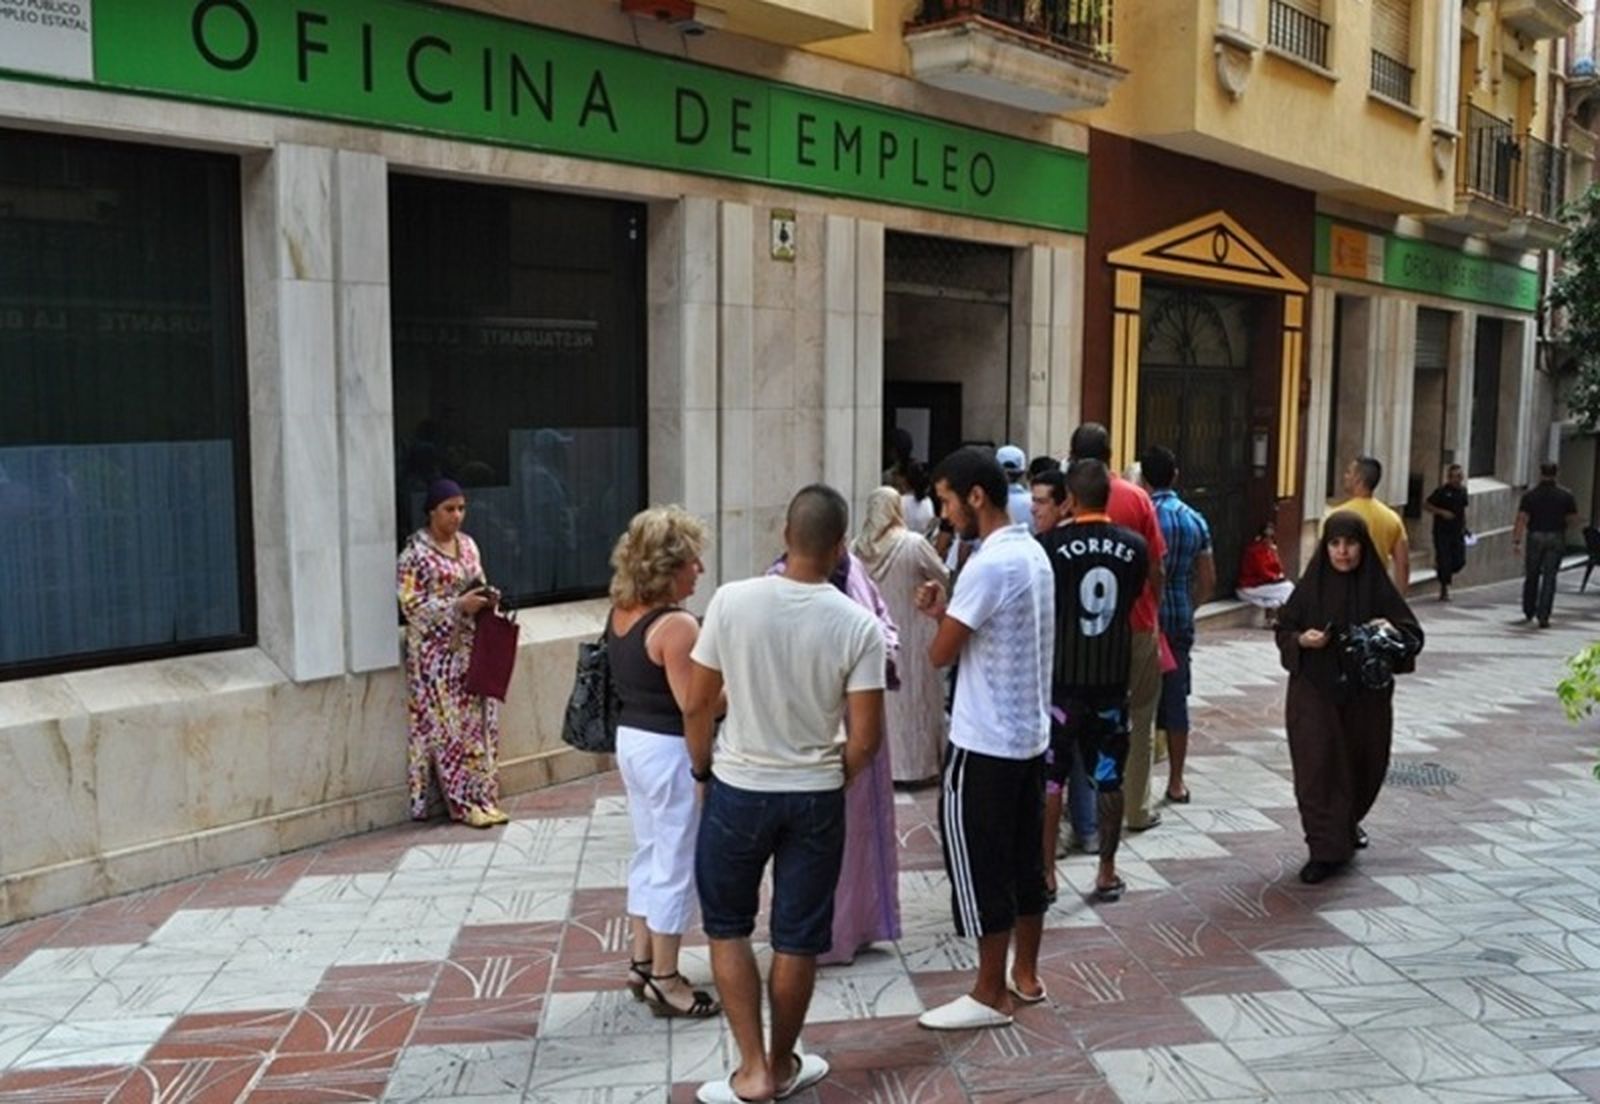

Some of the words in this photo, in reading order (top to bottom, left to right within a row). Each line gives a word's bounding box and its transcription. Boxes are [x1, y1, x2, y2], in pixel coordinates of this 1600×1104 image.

[0, 7, 39, 23] MPLEO
[41, 13, 89, 33] ESTATAL
[191, 0, 619, 133] OFICINA
[674, 86, 752, 156] DE
[797, 113, 995, 197] EMPLEO
[1057, 537, 1136, 562] TORRES
[1080, 566, 1118, 637] 9
